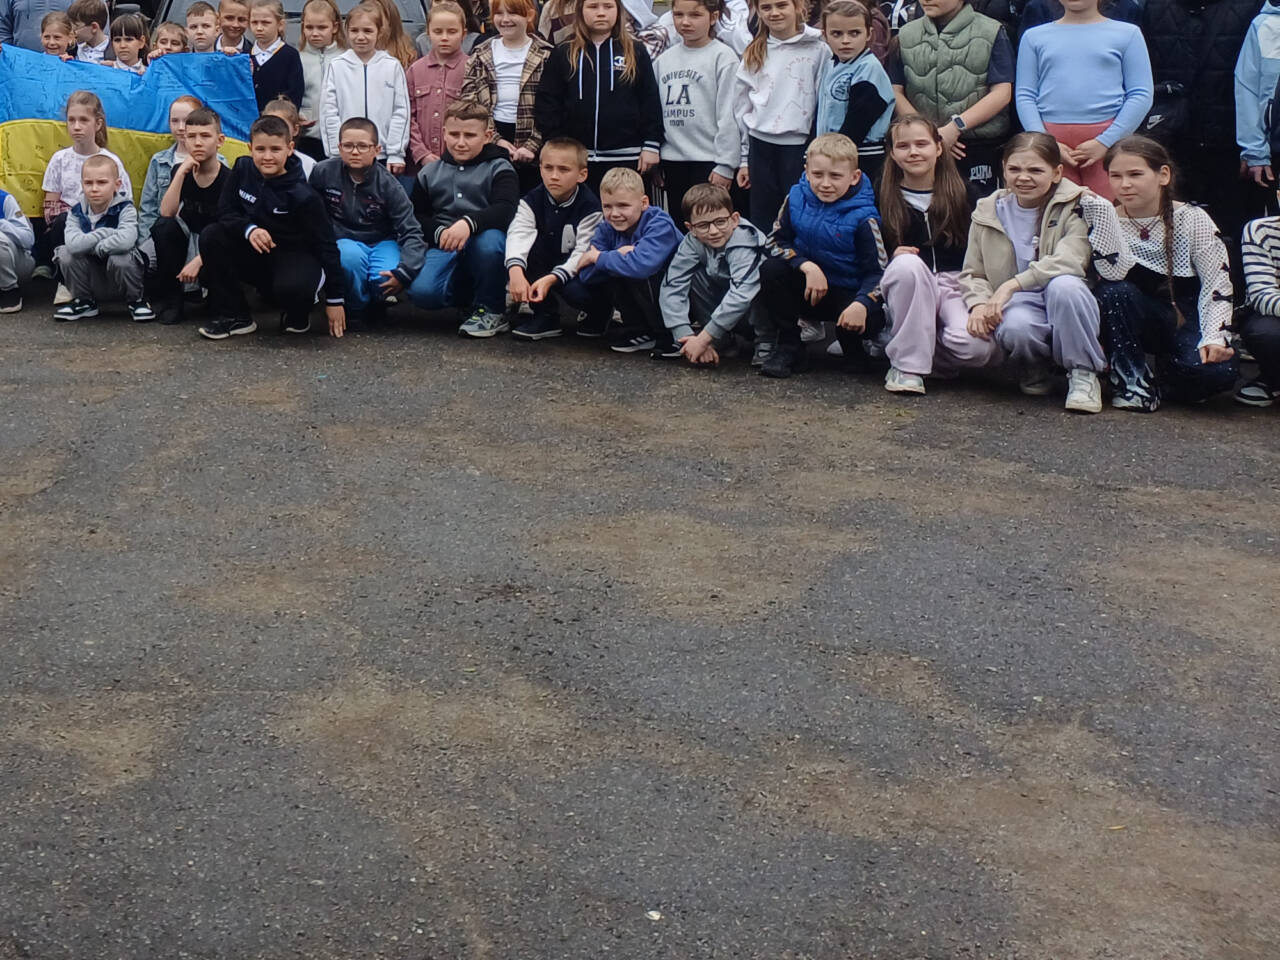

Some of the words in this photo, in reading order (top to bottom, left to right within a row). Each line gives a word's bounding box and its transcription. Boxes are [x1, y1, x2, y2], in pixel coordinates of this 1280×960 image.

[665, 84, 692, 105] LA
[970, 165, 993, 180] PUMA
[238, 189, 257, 204] NIKE
